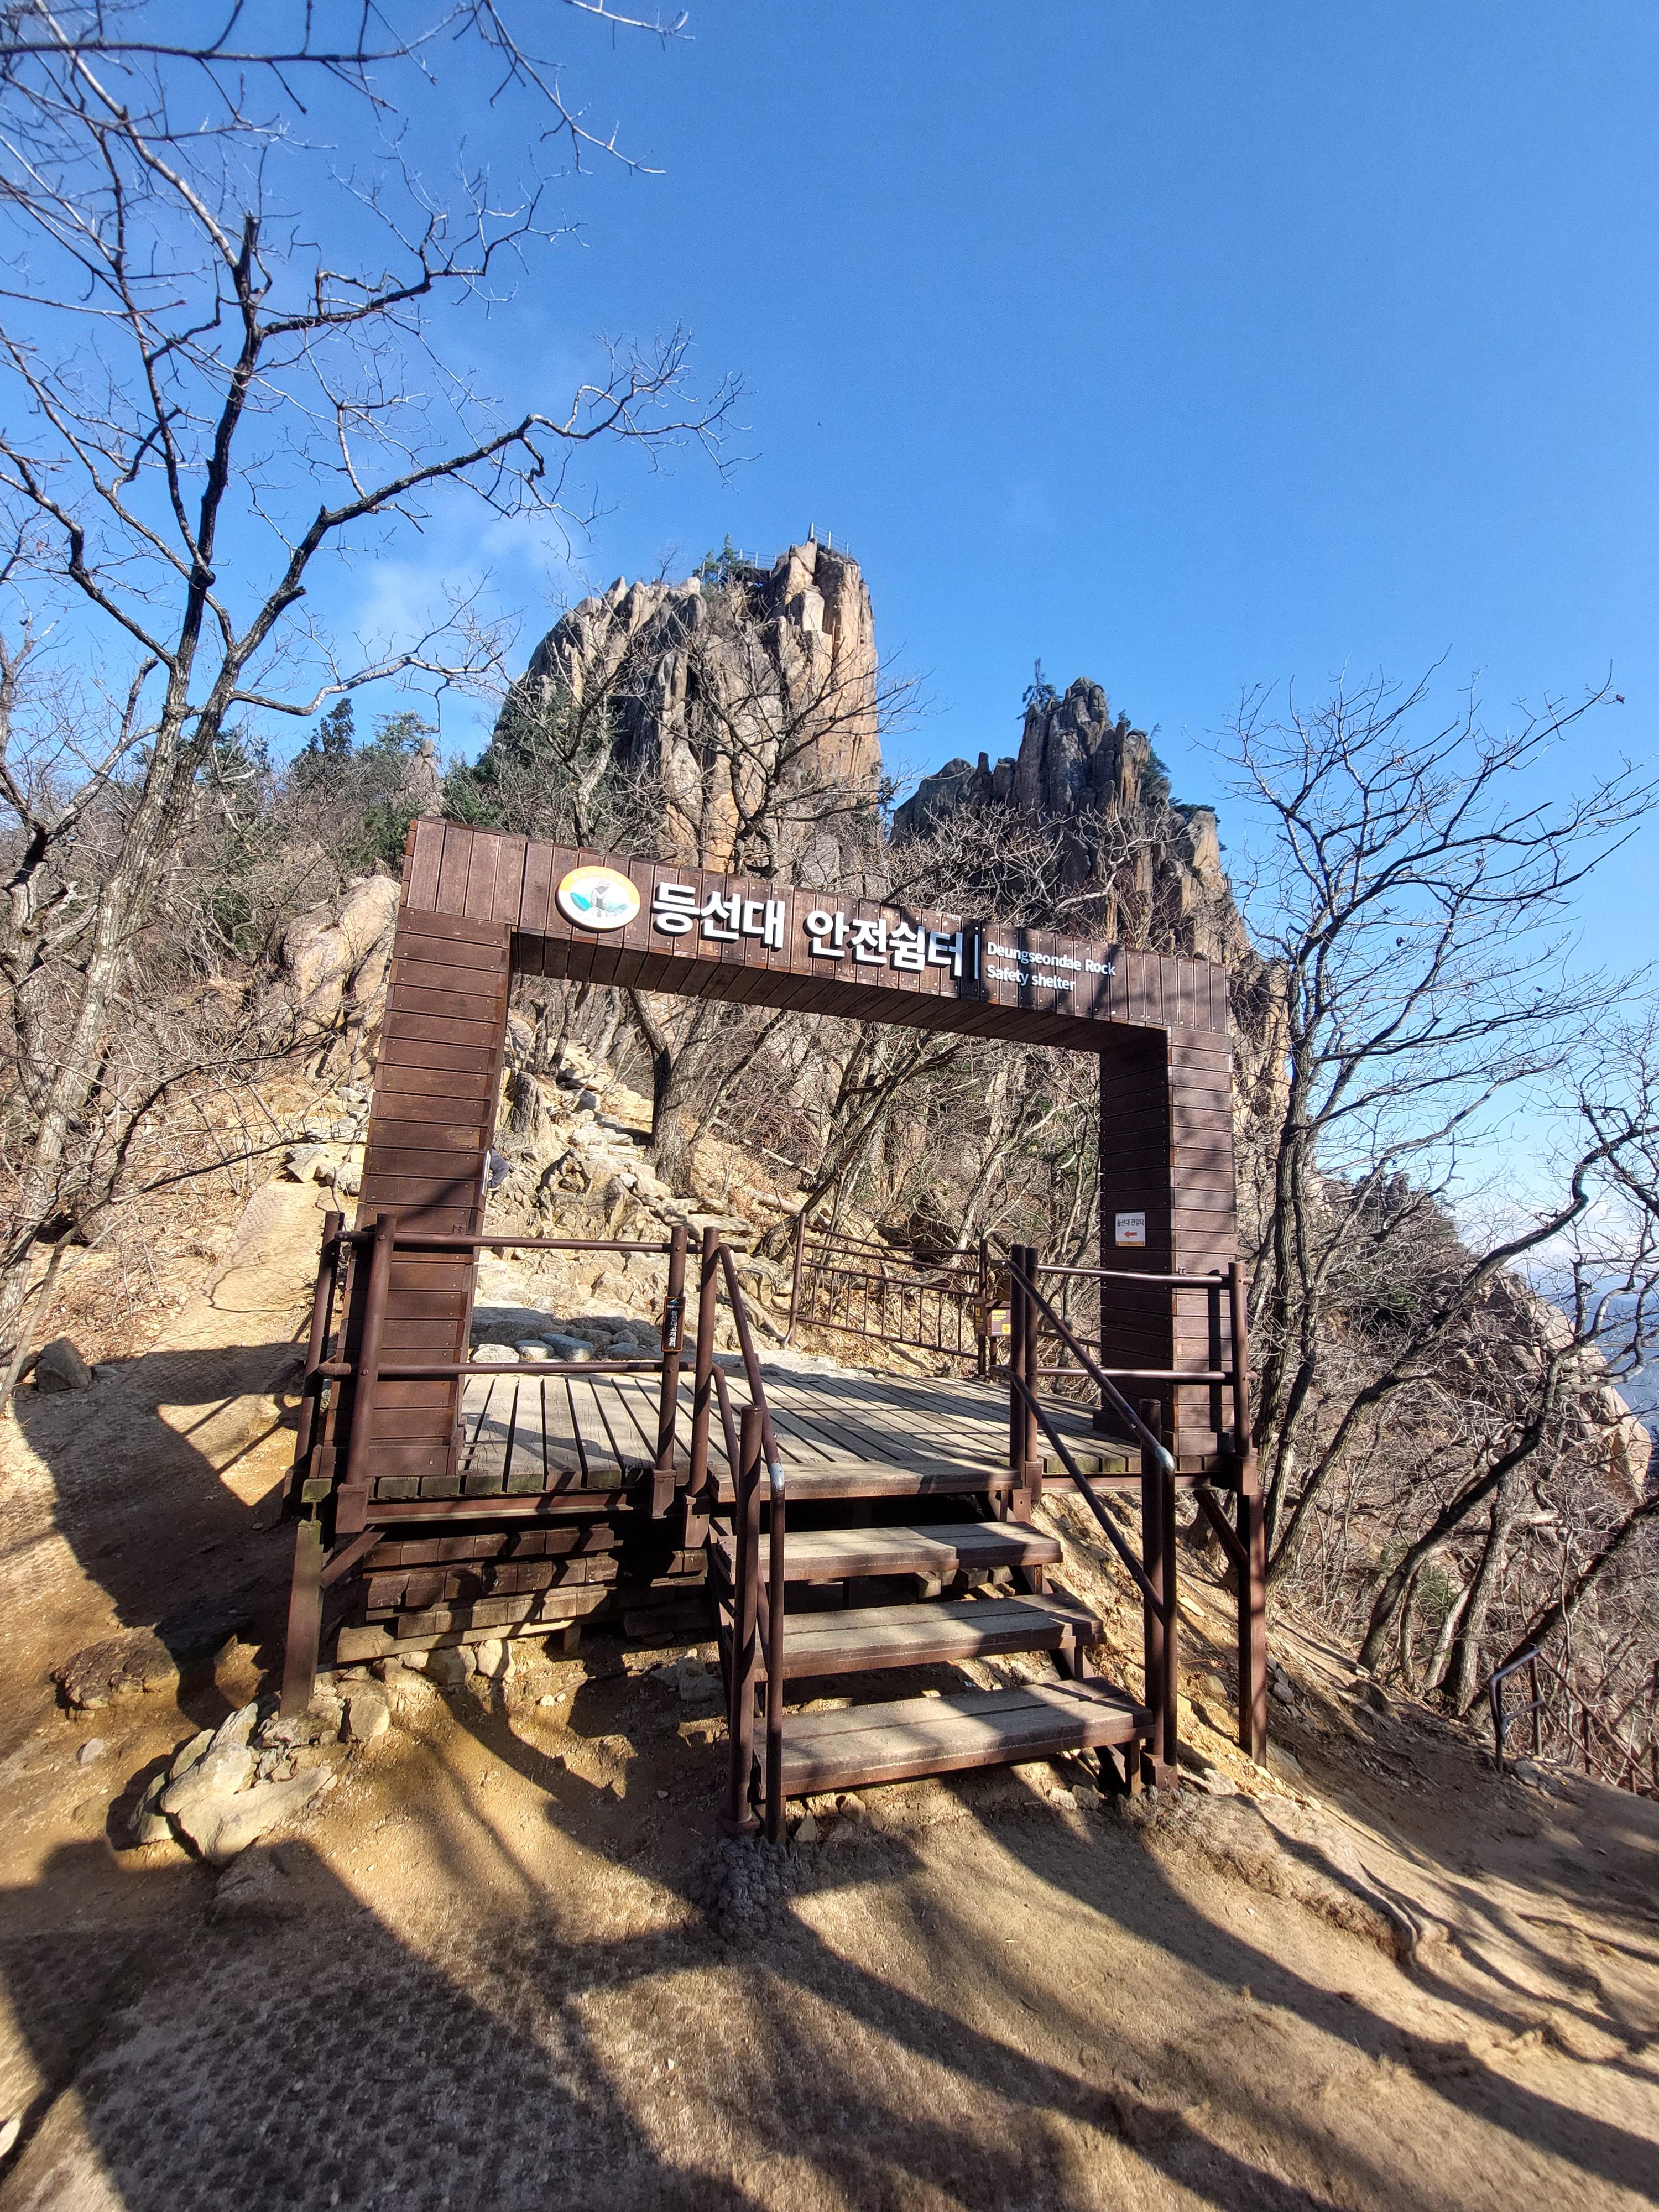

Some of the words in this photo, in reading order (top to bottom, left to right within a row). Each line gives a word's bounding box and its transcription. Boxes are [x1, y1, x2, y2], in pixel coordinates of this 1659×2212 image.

[652, 881, 785, 948] 등선대
[806, 910, 963, 977] 안전쉼터
[987, 942, 1082, 970] Deungseondae
[1086, 959, 1116, 975] Rock
[987, 964, 1029, 985] Safety
[1032, 972, 1076, 990] shelter
